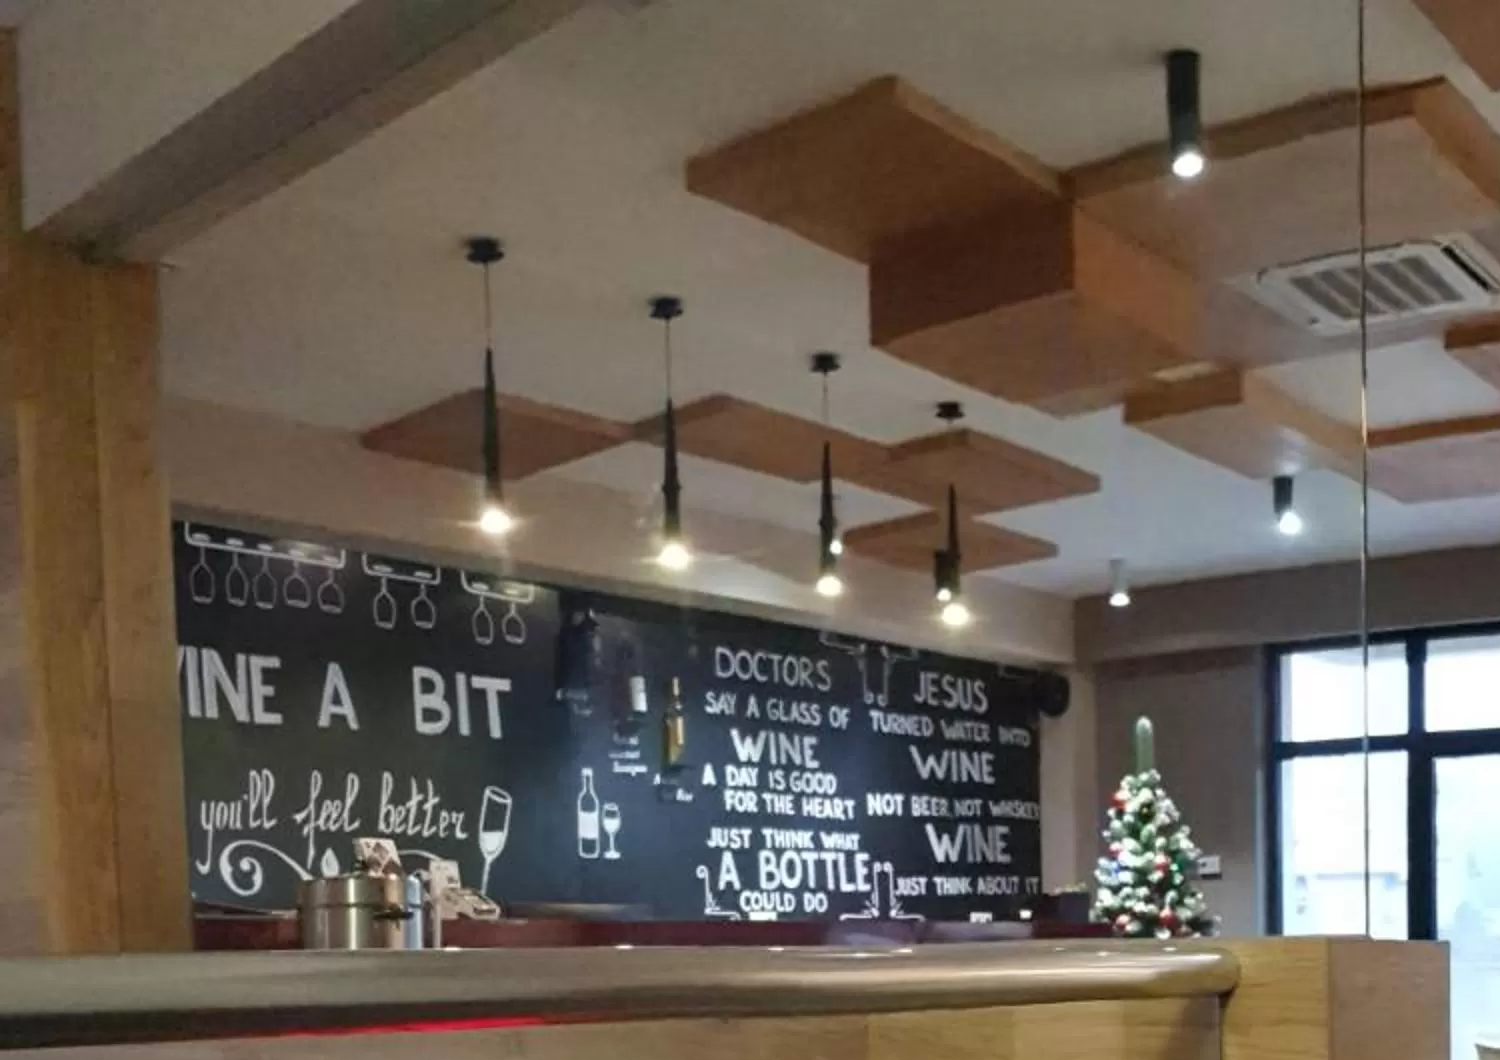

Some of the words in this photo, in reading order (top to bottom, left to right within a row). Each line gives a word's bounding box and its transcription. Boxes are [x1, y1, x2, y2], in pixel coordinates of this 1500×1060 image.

[715, 646, 832, 691] DOCTORS
[177, 645, 284, 725] INE
[317, 662, 359, 730] A
[412, 666, 512, 739] BIT
[704, 691, 737, 715] SAY
[746, 694, 760, 718] A
[766, 699, 822, 726] GLASS
[828, 705, 851, 730] OF
[912, 671, 989, 714] JESUS
[869, 709, 934, 737] TURNED
[939, 718, 991, 743] WATER
[729, 727, 821, 769] WINE
[908, 744, 996, 785] WINE
[701, 763, 717, 786] A
[724, 765, 759, 788] DAY
[767, 769, 786, 790] IS
[789, 771, 837, 795] GOOD
[195, 768, 277, 875] you'll
[293, 769, 361, 870] feel
[378, 771, 468, 839] better
[723, 789, 759, 813] FOR
[761, 792, 796, 815] THE
[801, 796, 856, 821] HEART
[866, 793, 904, 816] NOT
[954, 799, 983, 817] NOT
[705, 827, 752, 849] JUST
[760, 828, 814, 849] THINK
[819, 831, 860, 850] WHAT
[925, 822, 1012, 863] WINE
[718, 850, 741, 890] A
[758, 849, 872, 892] BOTTLE
[895, 876, 928, 897] JUST
[932, 876, 973, 897] THINK
[976, 876, 1021, 896] ABOUT
[738, 889, 797, 913] COULD
[803, 891, 829, 913] DO
